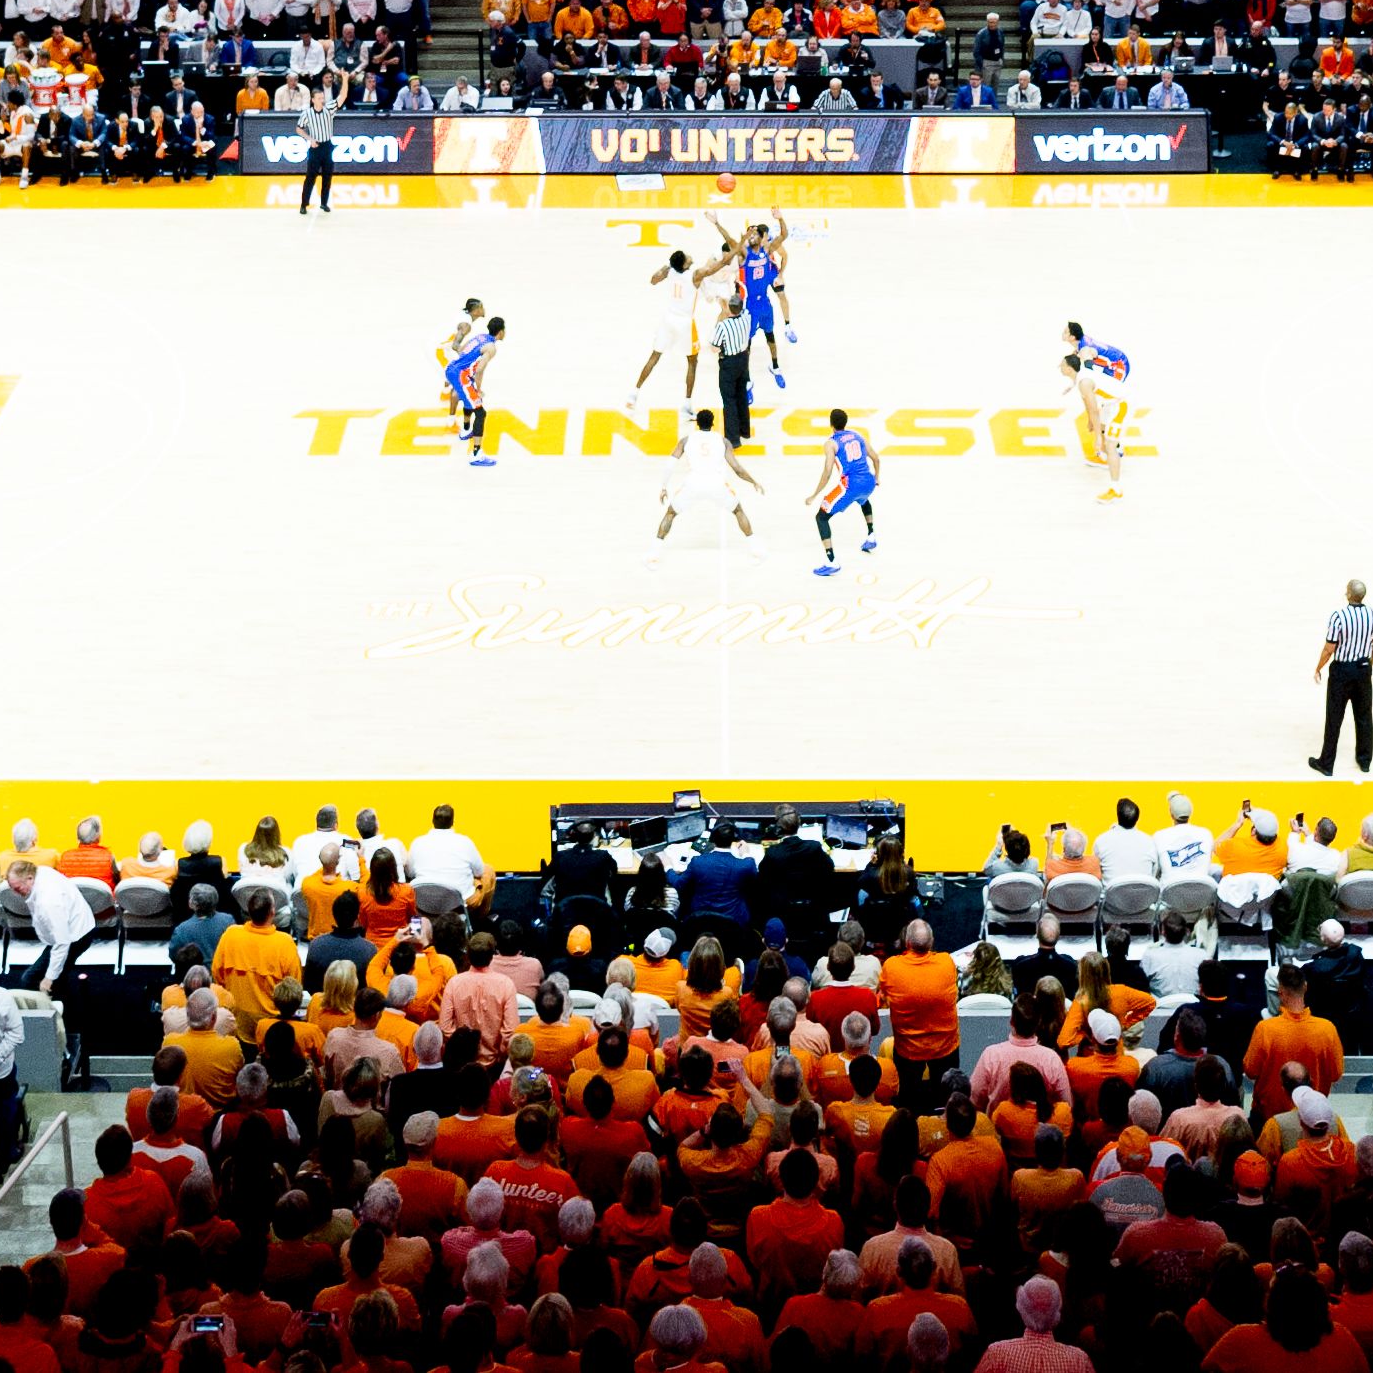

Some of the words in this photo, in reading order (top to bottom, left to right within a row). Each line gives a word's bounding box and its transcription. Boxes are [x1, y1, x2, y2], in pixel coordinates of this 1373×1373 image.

[262, 134, 399, 163] vezon
[1034, 126, 1173, 162] verizon
[606, 220, 695, 247] T
[291, 407, 1159, 456] TENNESSEE
[844, 440, 863, 463] 10
[500, 1177, 564, 1207] lunteer
